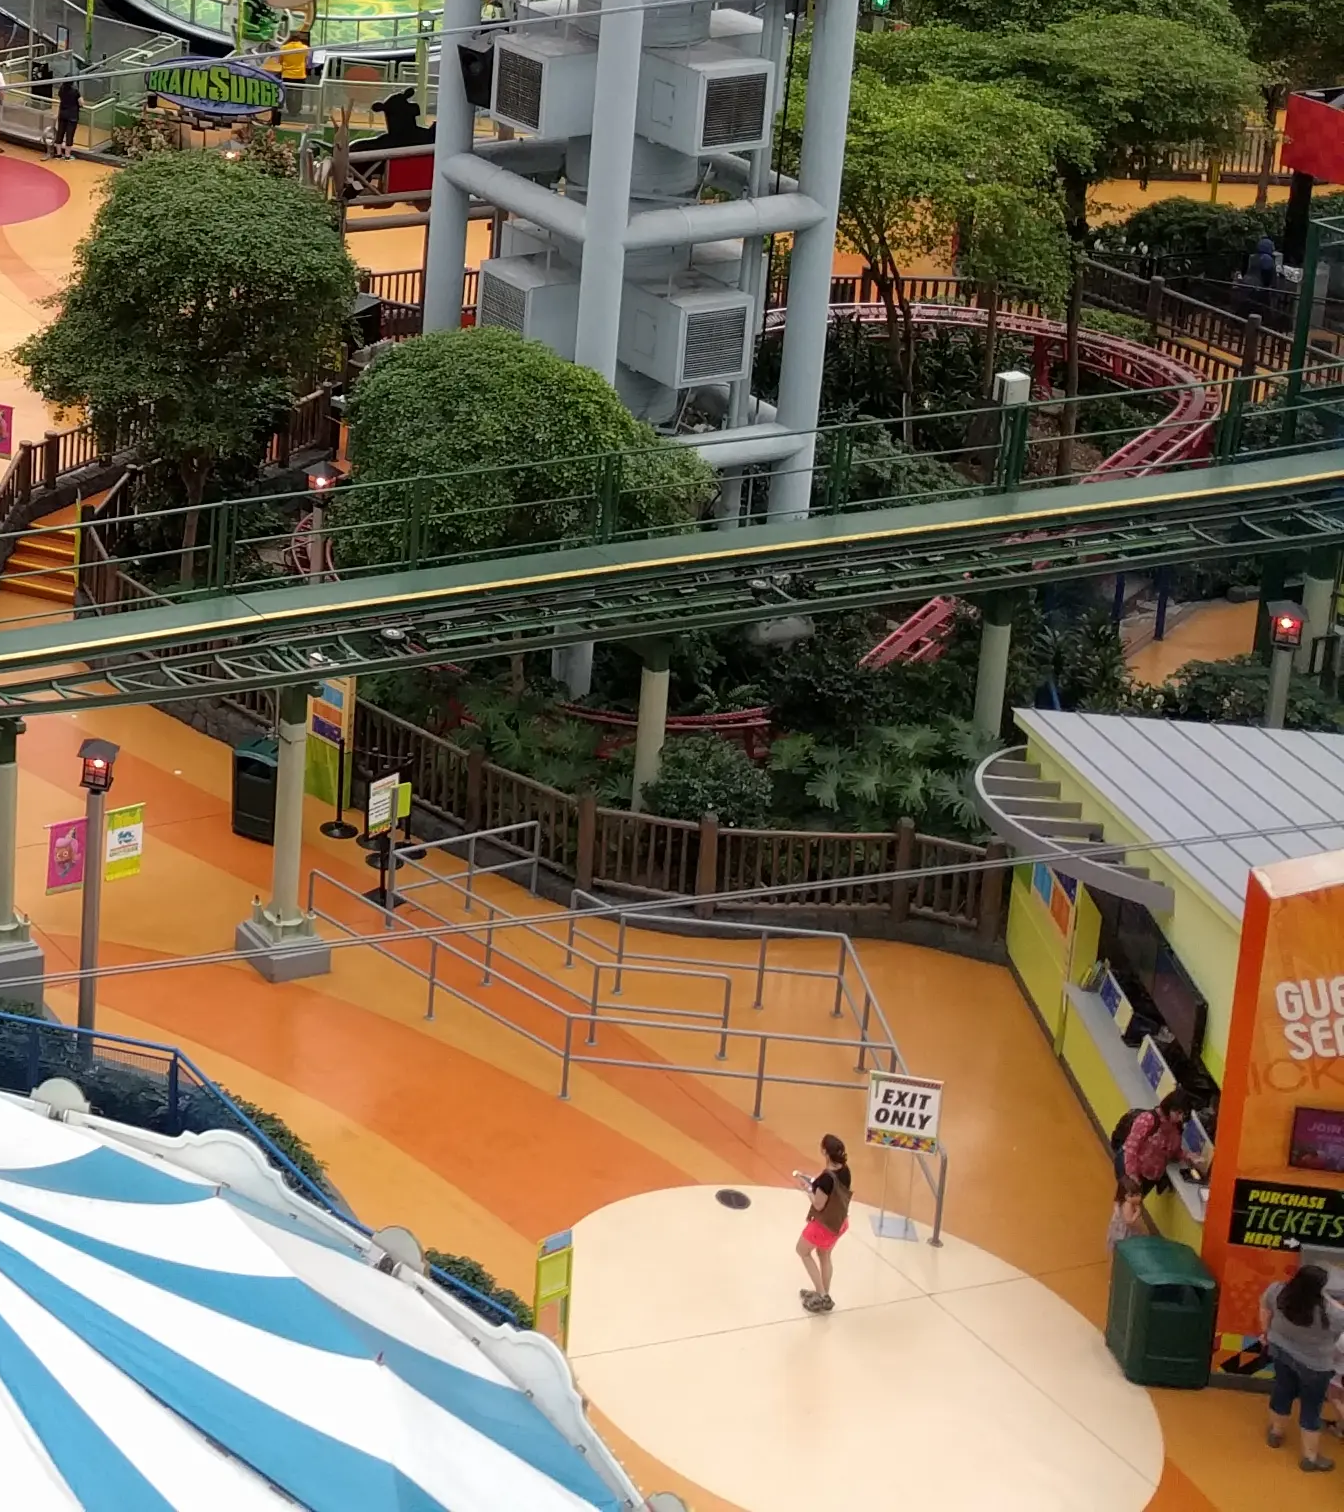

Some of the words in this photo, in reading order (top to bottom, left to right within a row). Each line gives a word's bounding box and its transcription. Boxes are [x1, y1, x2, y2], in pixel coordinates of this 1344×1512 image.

[148, 64, 280, 107] BRAINSURGE
[882, 1088, 932, 1110] EXIT
[875, 1107, 933, 1130] ONLY
[1248, 1189, 1327, 1210] PURCHASE
[1245, 1205, 1344, 1239] TICKETS
[1243, 1230, 1282, 1248] HERE
